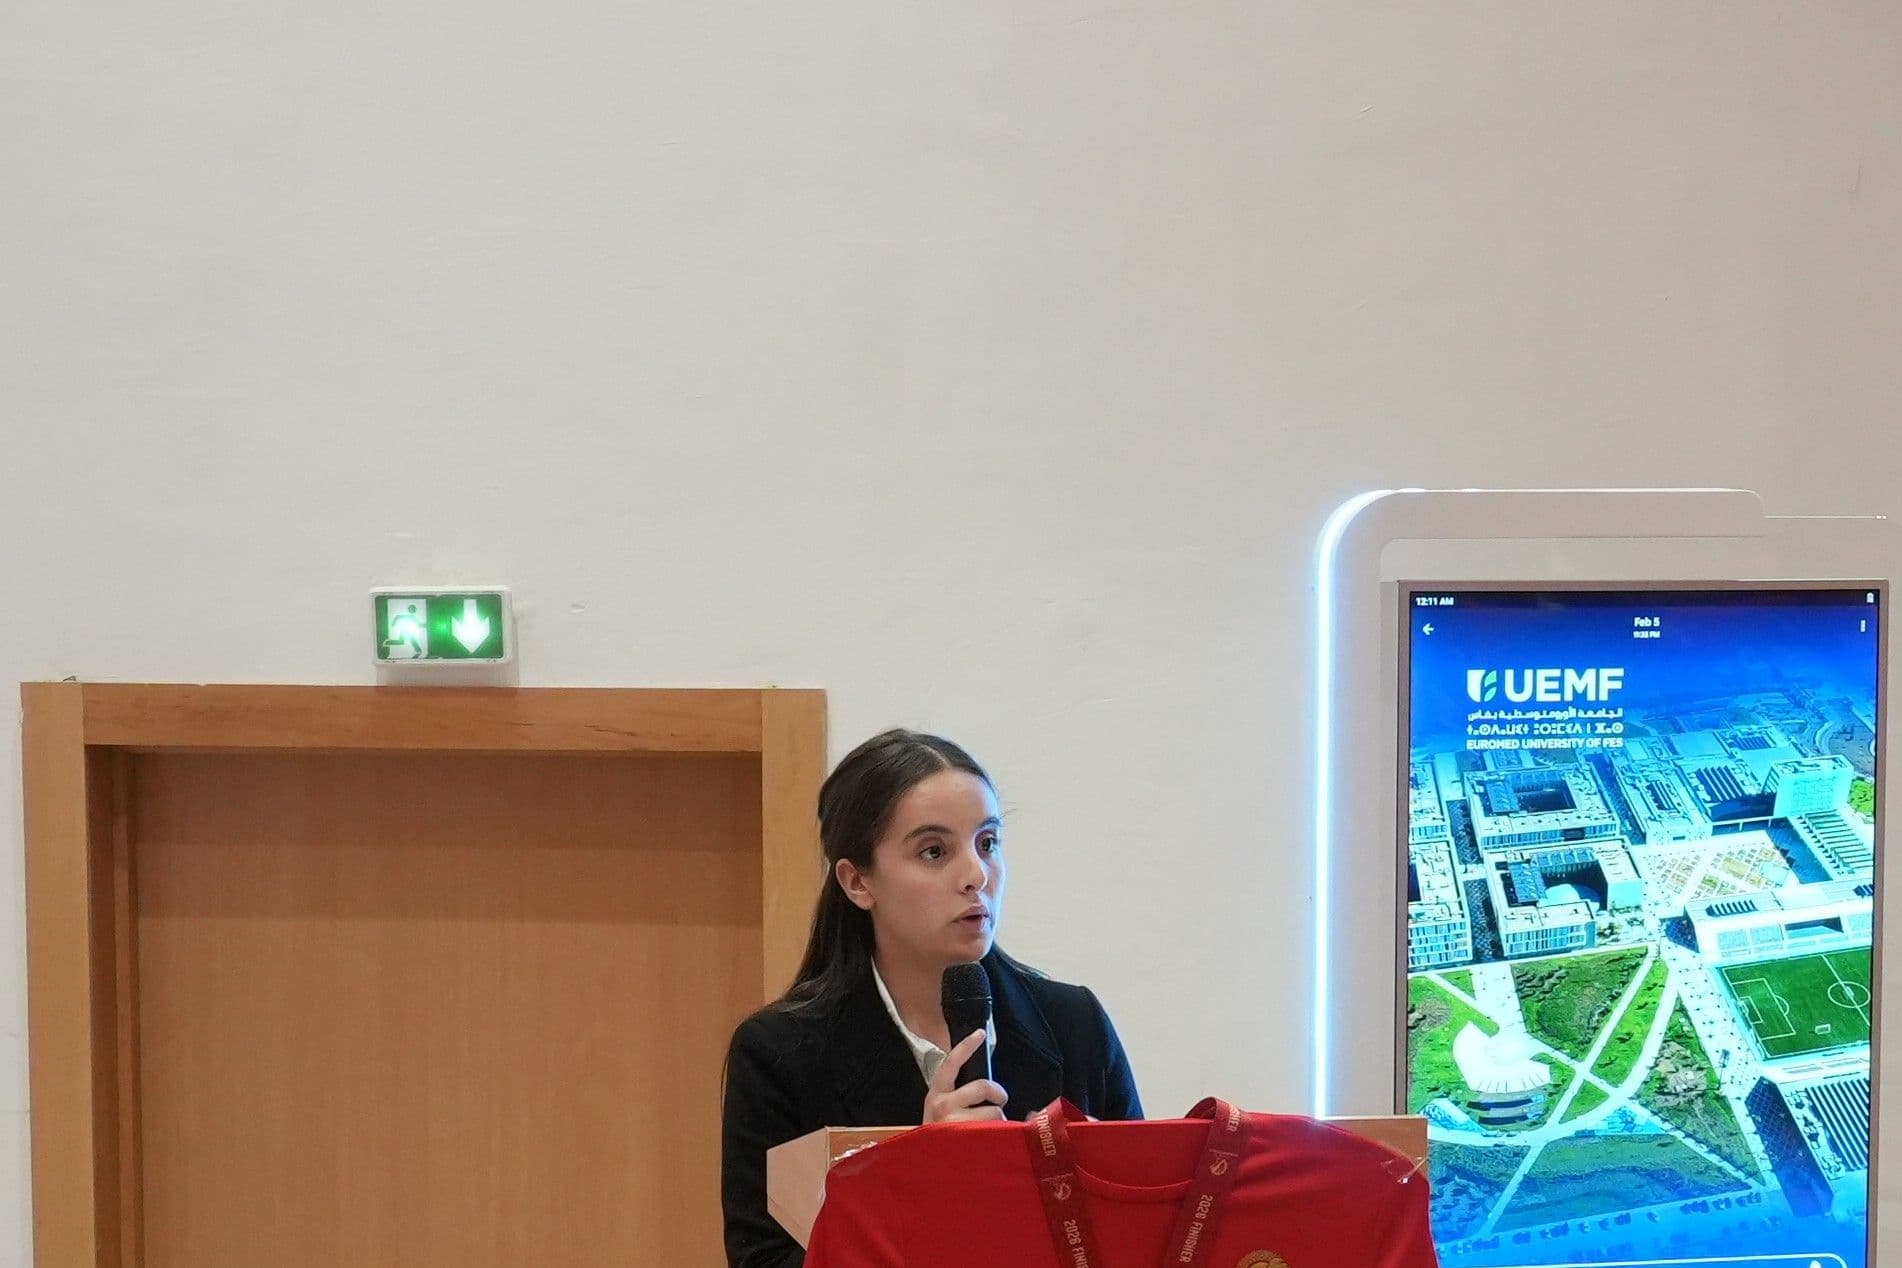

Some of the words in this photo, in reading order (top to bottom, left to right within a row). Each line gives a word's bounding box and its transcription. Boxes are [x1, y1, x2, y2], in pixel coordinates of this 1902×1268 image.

[1439, 597, 1454, 606] AM
[1634, 616, 1652, 627] Feb
[1653, 616, 1660, 627] 5
[1504, 668, 1624, 702] UEMF
[1466, 738, 1520, 750] EUROMED
[1522, 738, 1585, 749] UNIVERSITY
[1586, 738, 1601, 749] OF
[1603, 738, 1624, 749] FES
[1195, 1194, 1213, 1219] 2026
[1064, 1219, 1081, 1245] 2026
[1179, 1222, 1203, 1263] FINISHER
